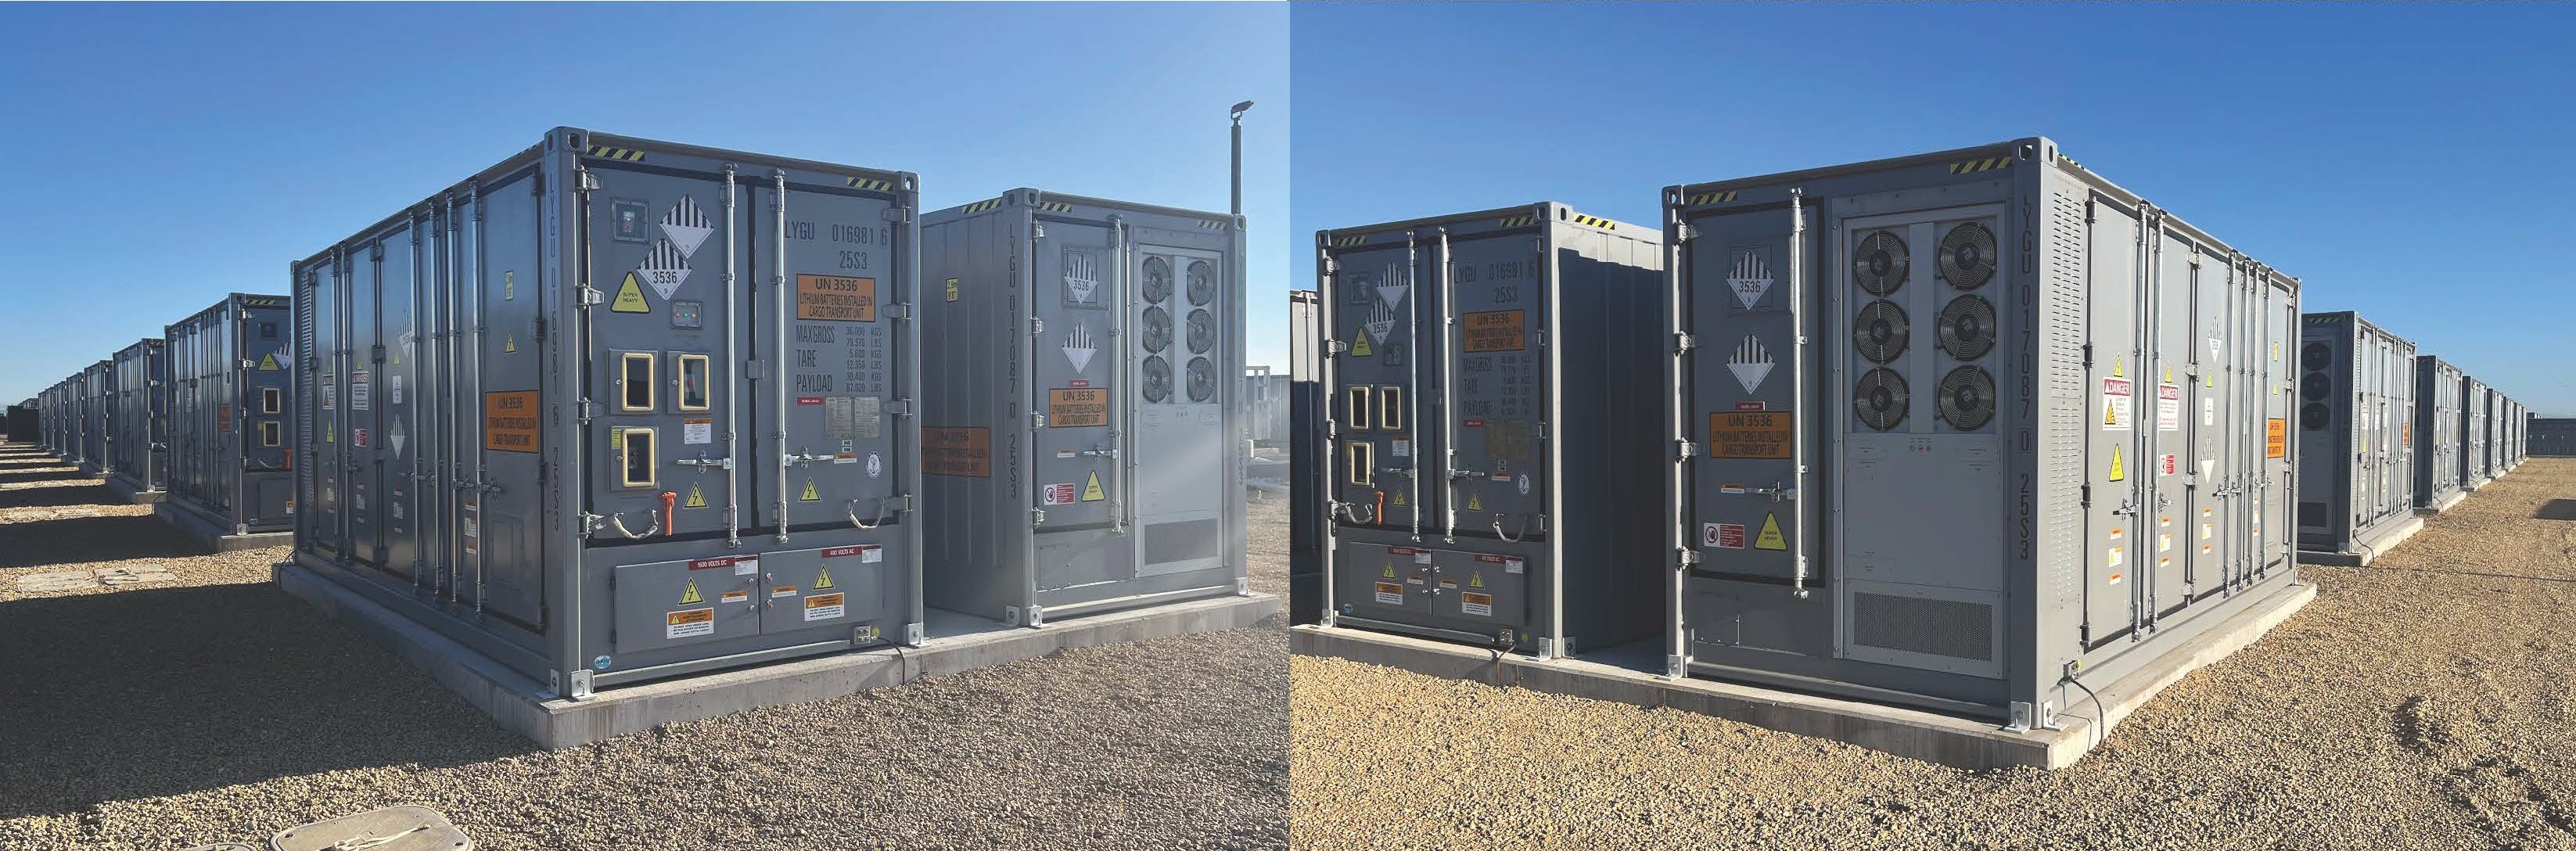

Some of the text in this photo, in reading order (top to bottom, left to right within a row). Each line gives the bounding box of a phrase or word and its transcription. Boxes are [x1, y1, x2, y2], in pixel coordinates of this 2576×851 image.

[785, 220, 887, 246] LYGU 016981 6
[2023, 193, 2032, 274] LYGU
[839, 250, 867, 269] 25S3
[652, 271, 677, 284] 3536
[1455, 266, 1476, 283] LYGU
[815, 278, 857, 292] UN 3536
[1073, 279, 1089, 291] 3536
[1739, 280, 1760, 293] 3536
[799, 293, 819, 305] LITHIUM
[821, 293, 842, 306] BATTERIES
[844, 294, 867, 307] INSTALLED
[1494, 286, 1518, 303] 25S3
[809, 306, 864, 319] CARGO TRANSPORT UNIT
[796, 325, 835, 343] MAXGROSS
[871, 326, 882, 336] KGS
[1373, 323, 1388, 334] 3536
[871, 338, 882, 347] LBS
[2021, 285, 2031, 418] 017087
[796, 350, 817, 368] TARE
[871, 349, 882, 358] KGS
[871, 360, 882, 369] LBS
[796, 374, 832, 393] PAYLOAD
[871, 372, 882, 381] KGS
[871, 382, 882, 392] LBS
[2110, 382, 2130, 395] DANGER
[1063, 390, 1094, 401] UN 3536
[2161, 386, 2177, 399] DANGER
[1728, 415, 1773, 426] UN 3536
[2020, 473, 2029, 560] 25S3
